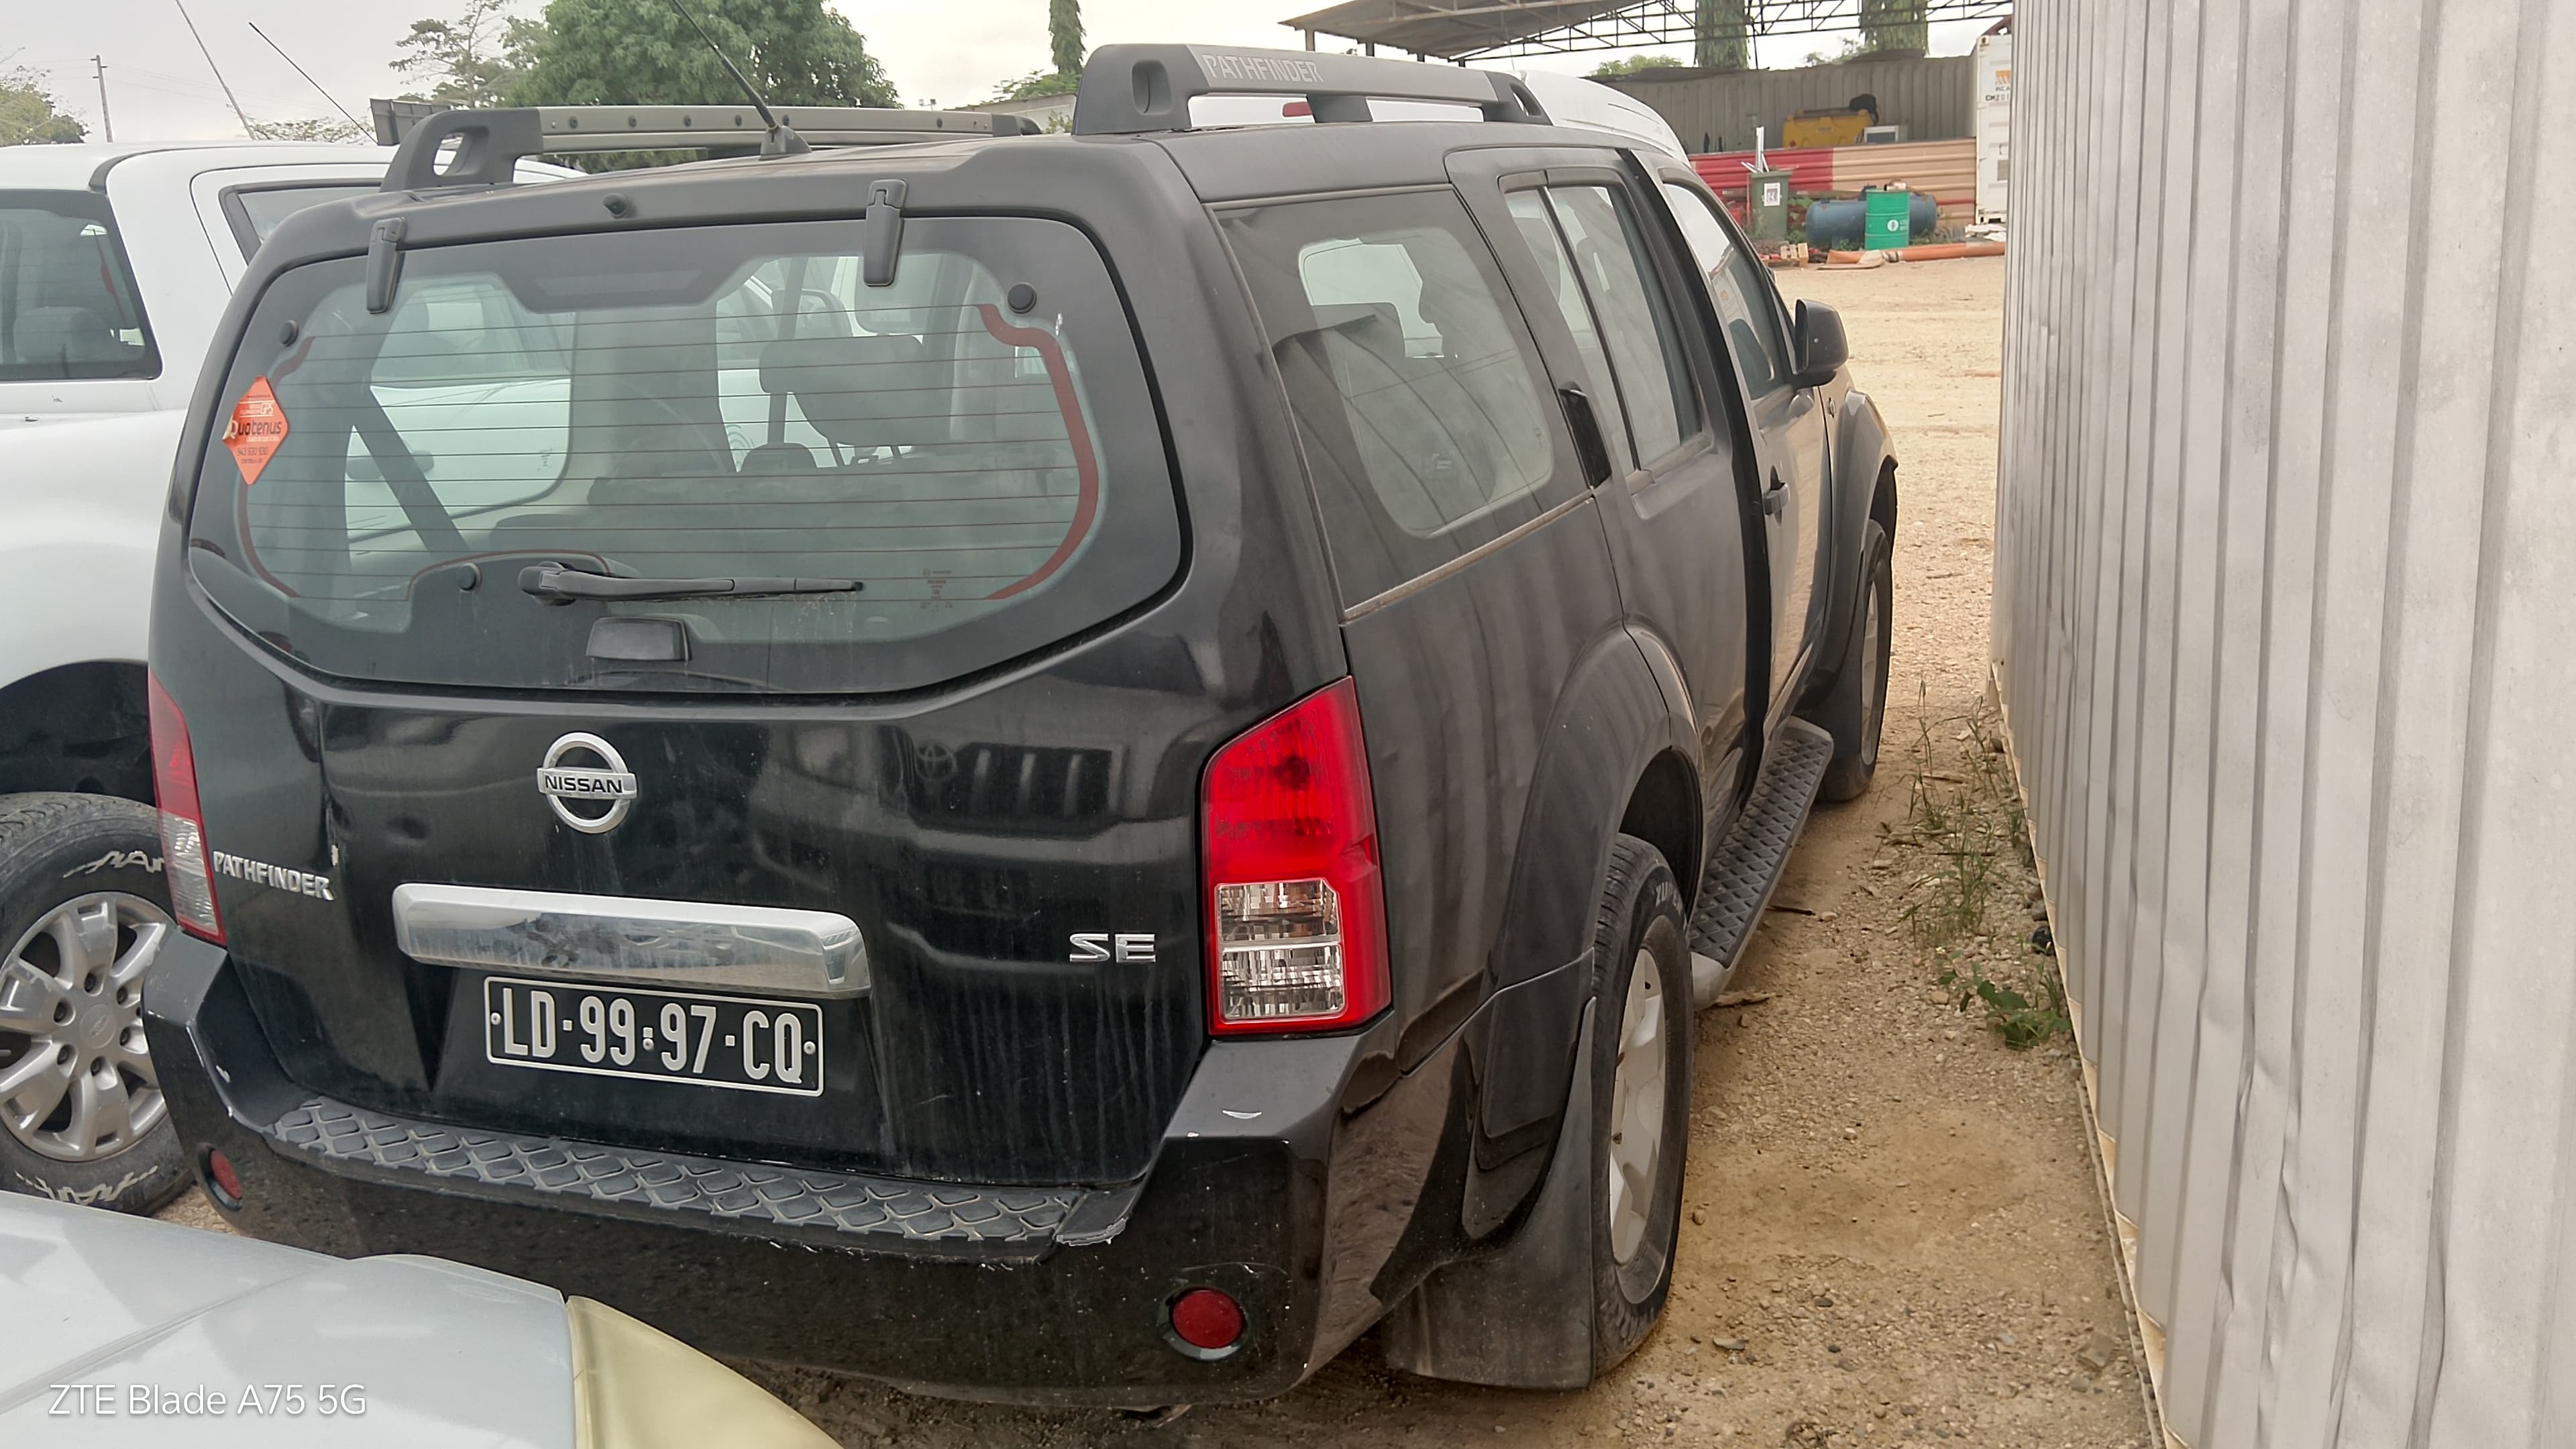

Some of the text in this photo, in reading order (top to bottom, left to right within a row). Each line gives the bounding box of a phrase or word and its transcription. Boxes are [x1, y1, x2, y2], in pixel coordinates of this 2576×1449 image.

[1201, 54, 1326, 83] PATHFINDER
[229, 419, 282, 439] Quatenus
[545, 775, 623, 794] NISSAN
[213, 851, 335, 901] PATHFINDER
[1069, 933, 1157, 963] SE
